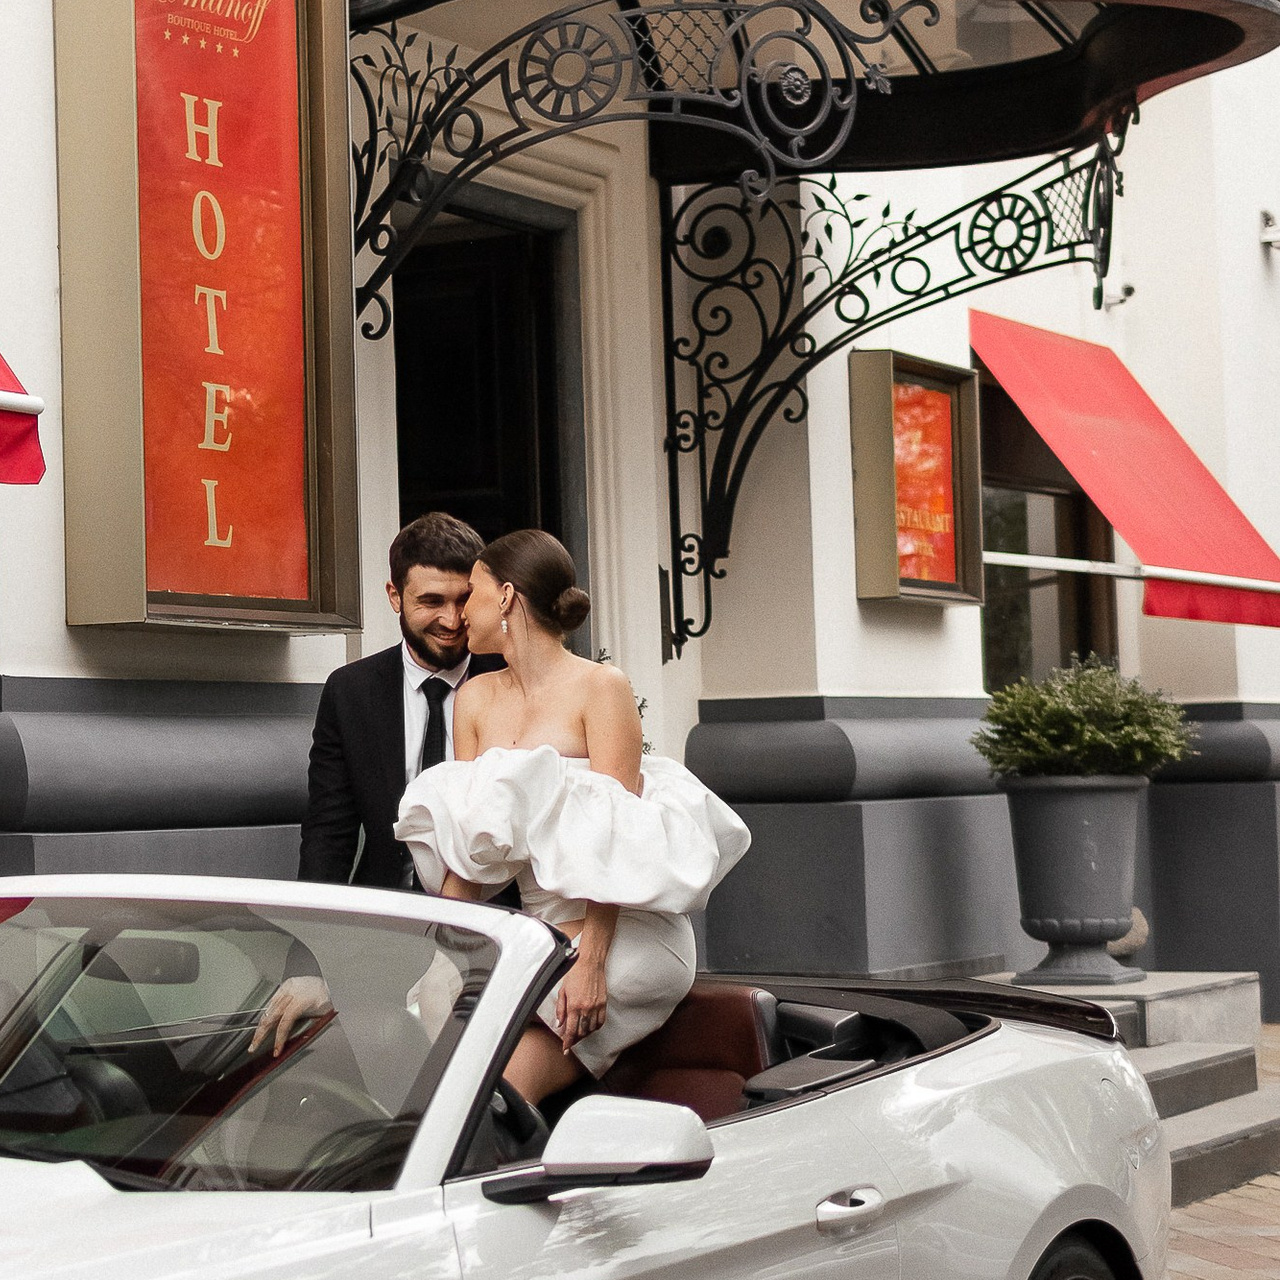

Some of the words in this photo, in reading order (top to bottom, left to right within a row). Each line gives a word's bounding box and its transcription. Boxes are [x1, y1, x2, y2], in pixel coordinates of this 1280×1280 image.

[167, 13, 211, 34] BOUTIQUE
[213, 25, 239, 40] HOTEL
[180, 92, 233, 548] HOTEL
